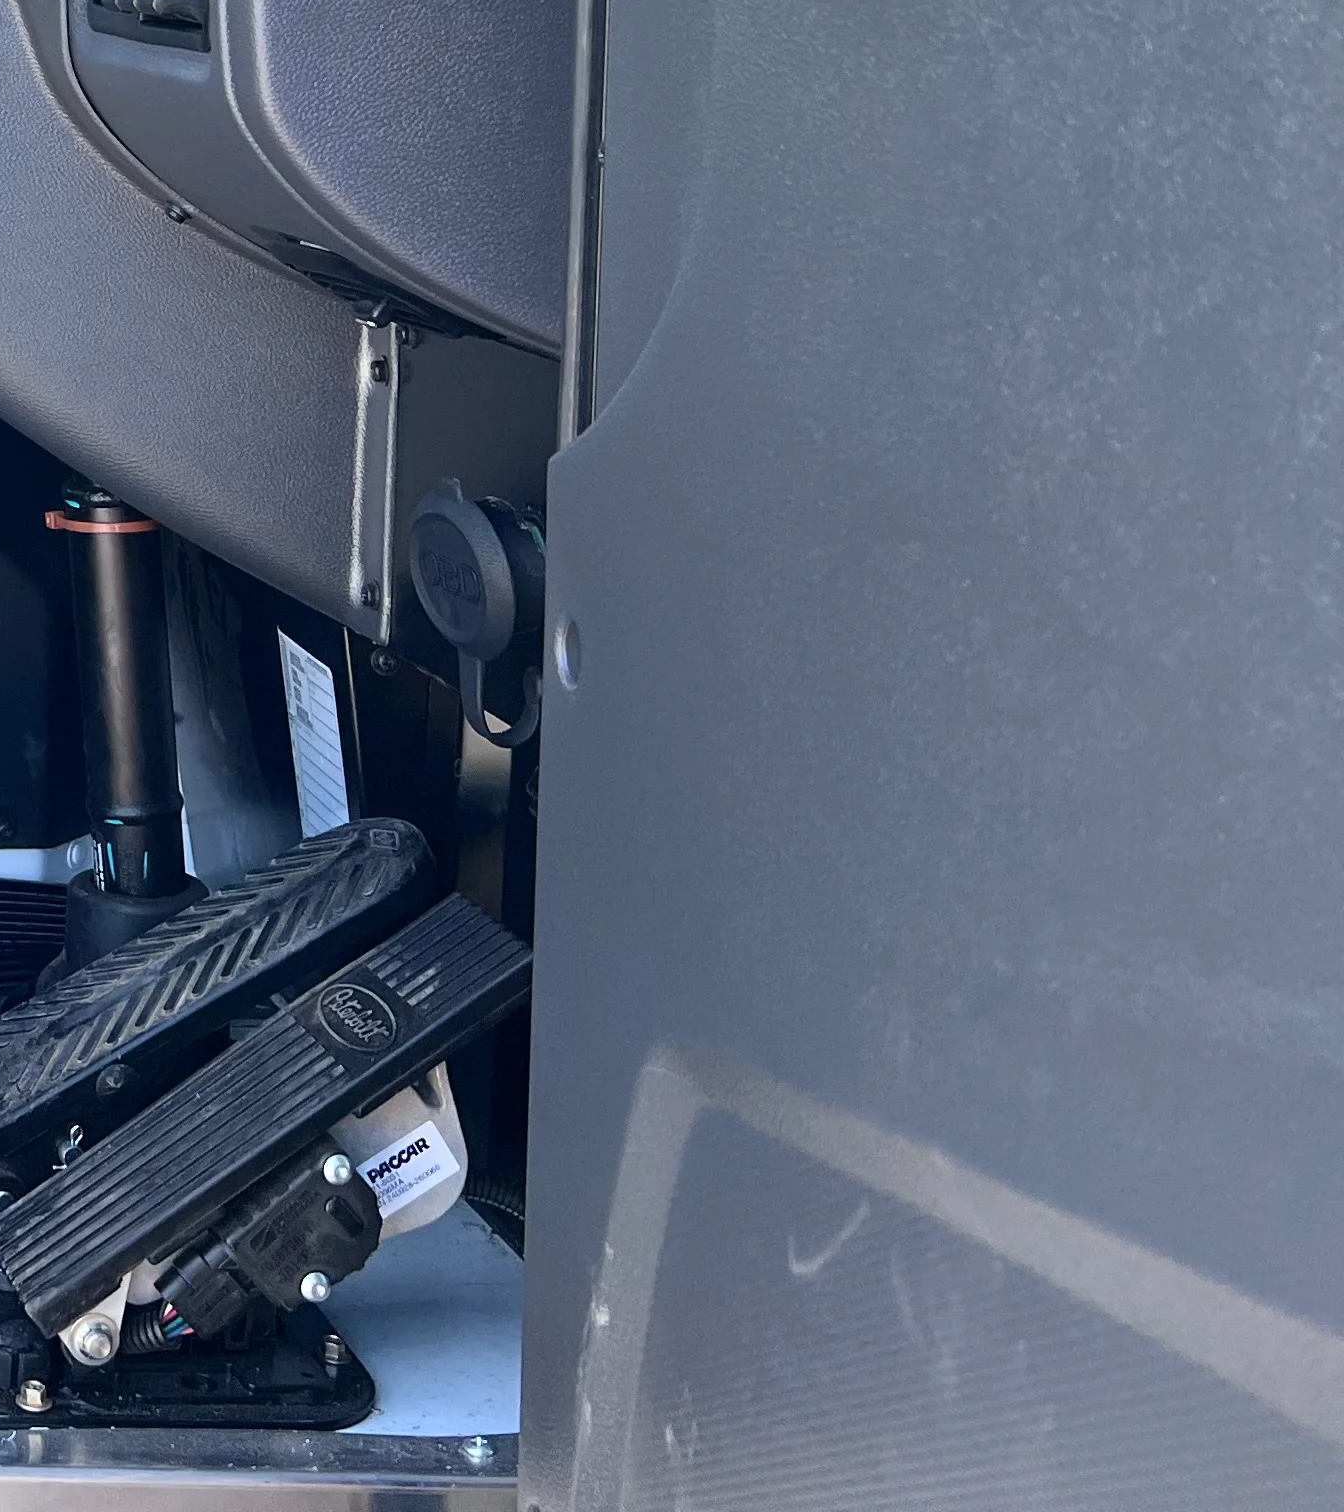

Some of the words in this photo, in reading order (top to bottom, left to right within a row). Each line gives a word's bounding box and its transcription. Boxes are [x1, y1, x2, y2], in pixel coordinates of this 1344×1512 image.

[420, 549, 481, 604] OBD
[321, 988, 390, 1042] Peterbilt
[366, 1137, 430, 1184] PACCAR
